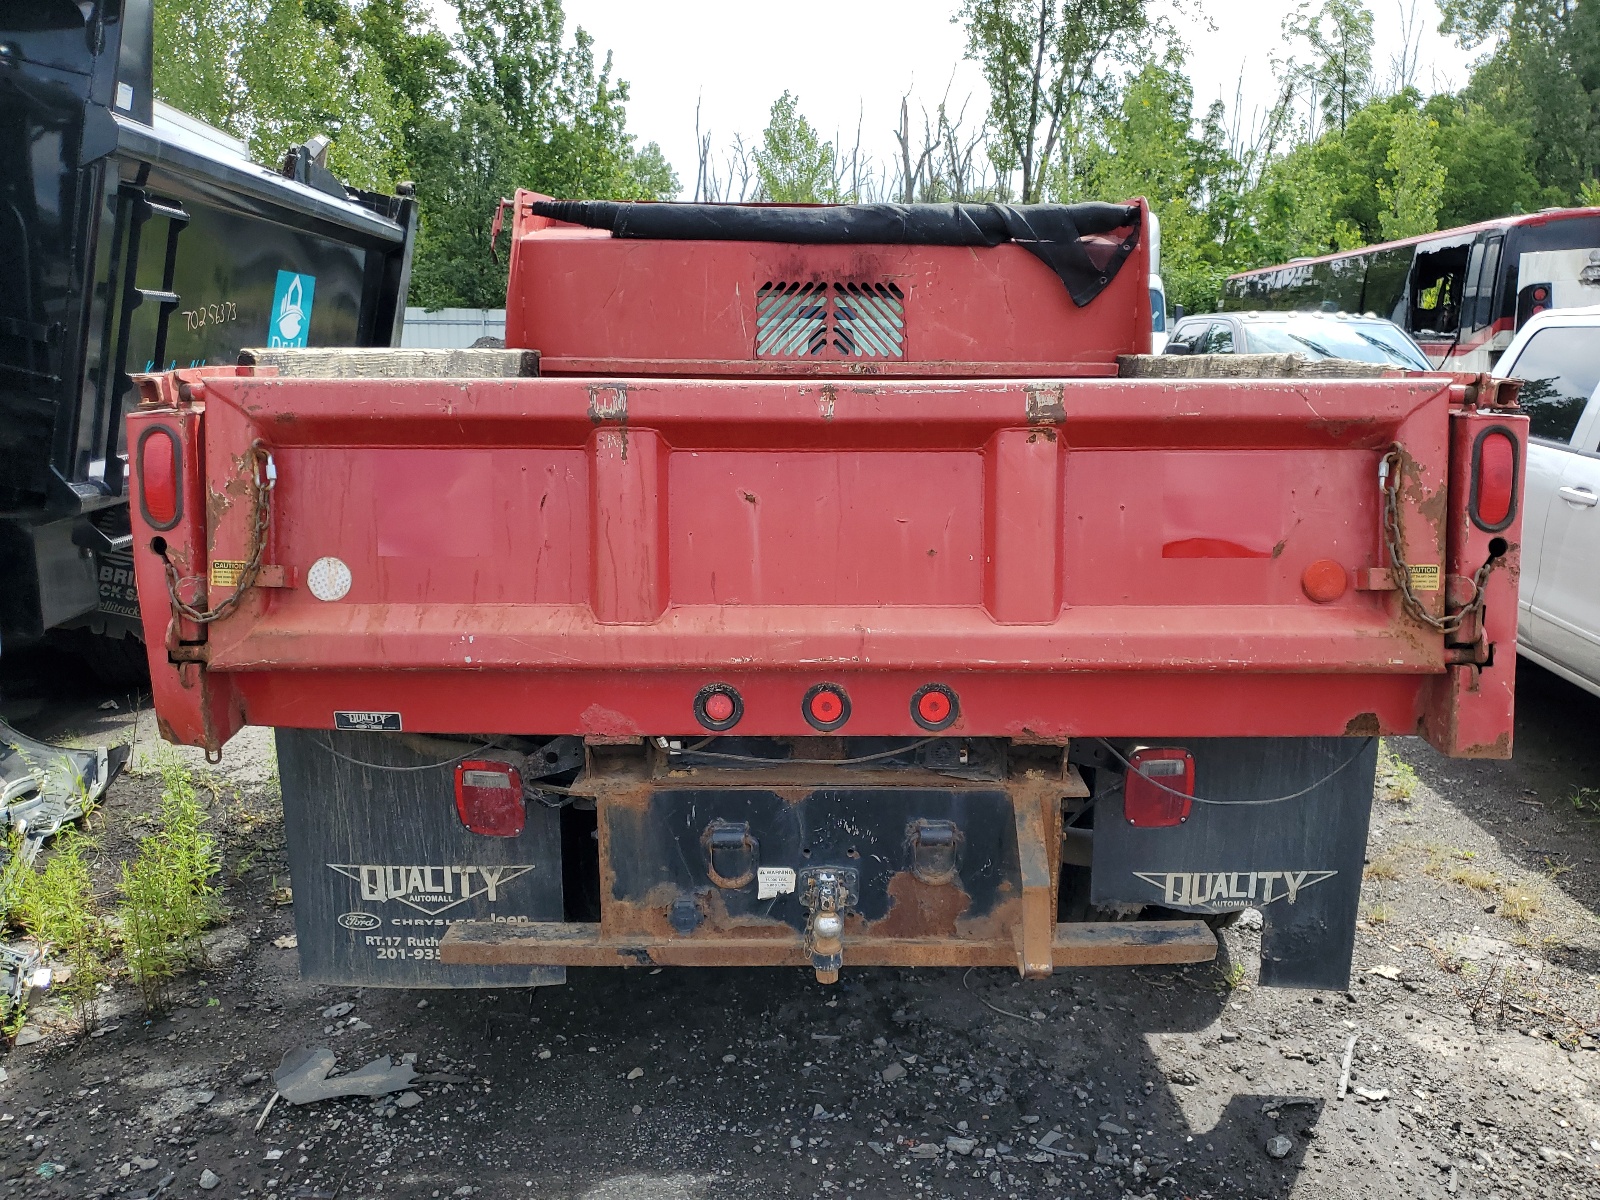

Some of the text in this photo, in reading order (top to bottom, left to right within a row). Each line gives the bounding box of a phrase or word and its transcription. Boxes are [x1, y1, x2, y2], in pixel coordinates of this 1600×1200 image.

[100, 566, 137, 587] BRI
[348, 713, 386, 724] QUALITY
[360, 865, 504, 903] QUALITY
[1165, 871, 1309, 906] QUALITY
[409, 895, 453, 903] AUTOMALL
[345, 915, 375, 927] Ford
[365, 935, 401, 947] RT.17
